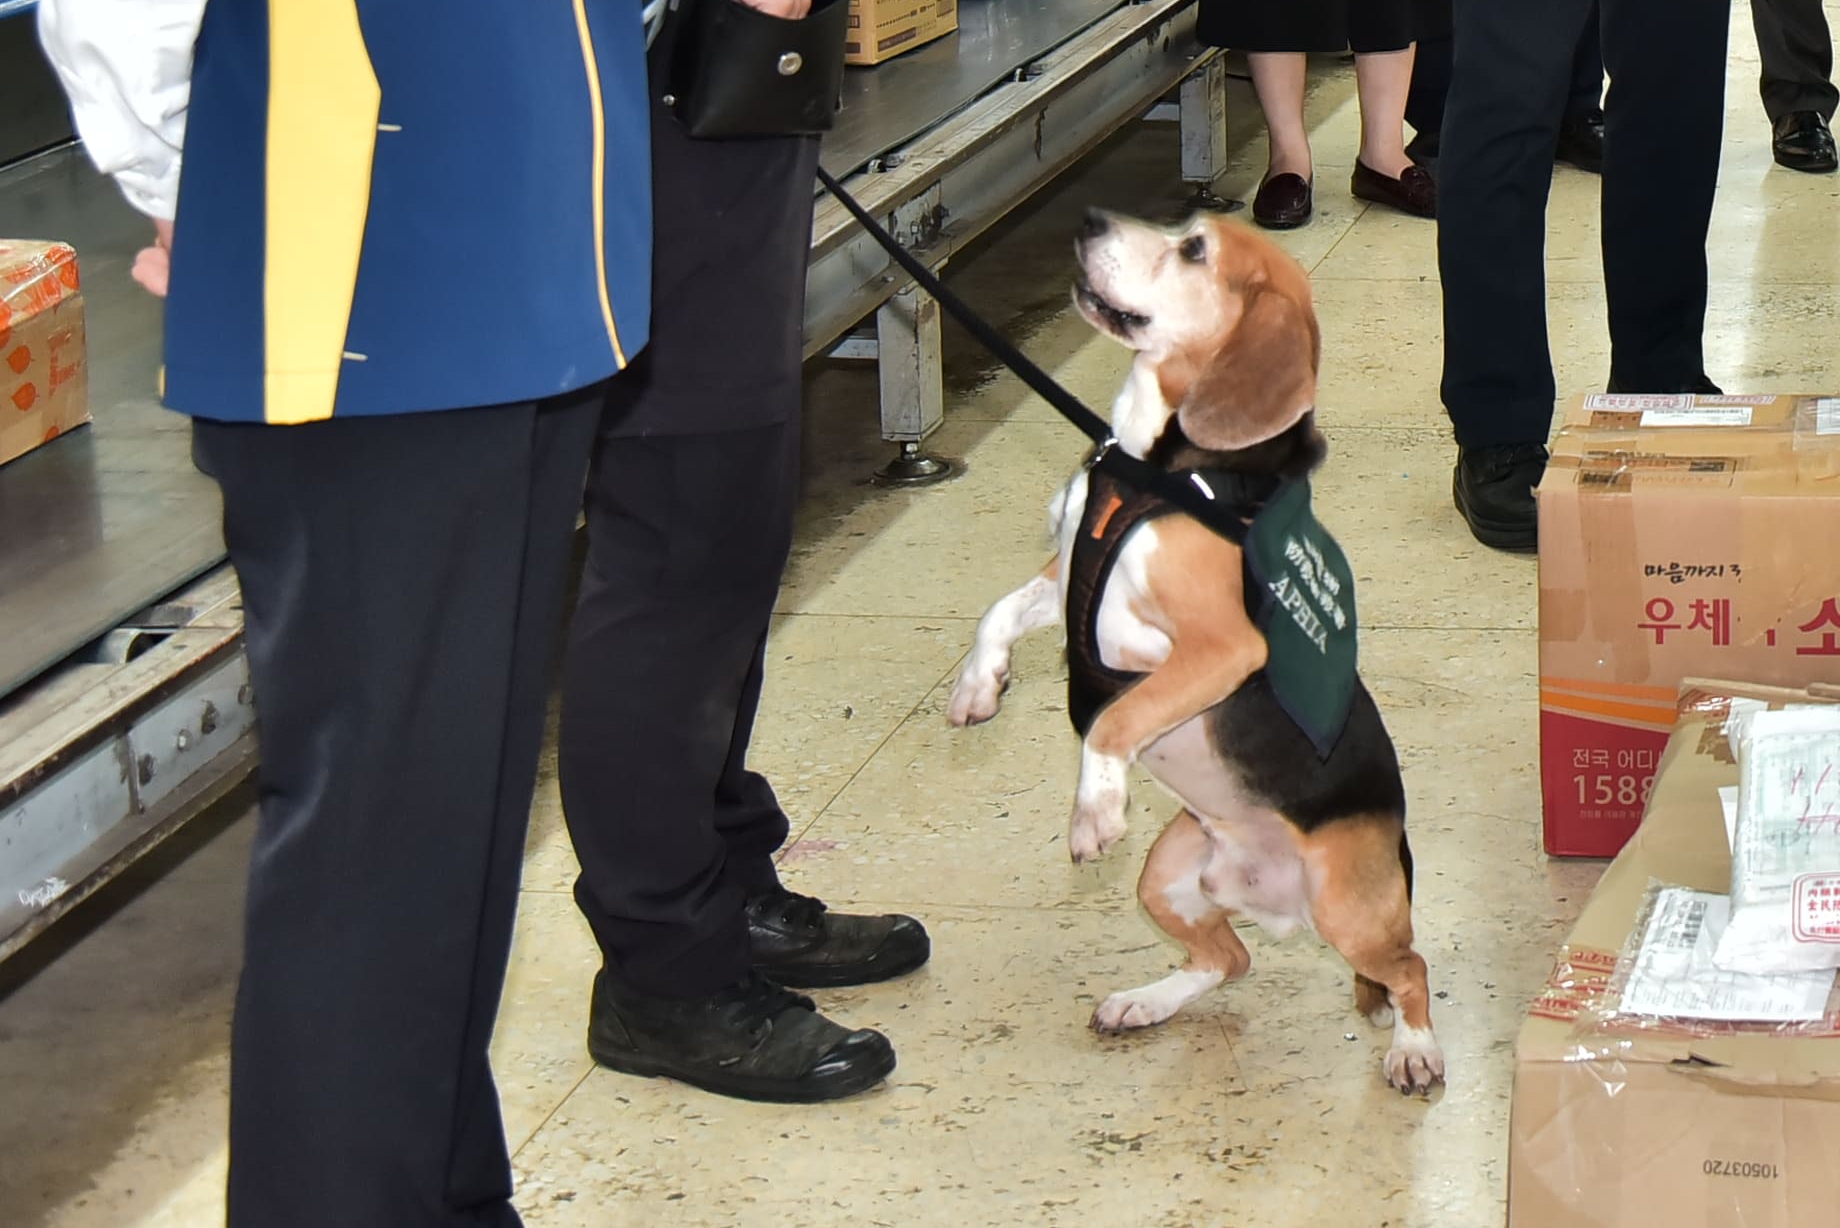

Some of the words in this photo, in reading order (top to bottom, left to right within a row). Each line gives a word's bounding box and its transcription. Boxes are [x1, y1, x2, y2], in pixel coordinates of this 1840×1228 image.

[1644, 562, 1723, 584] 마음까지
[1268, 572, 1328, 655] APHIA
[1573, 748, 1609, 769] 전국
[1703, 1159, 1778, 1179] 10503720
